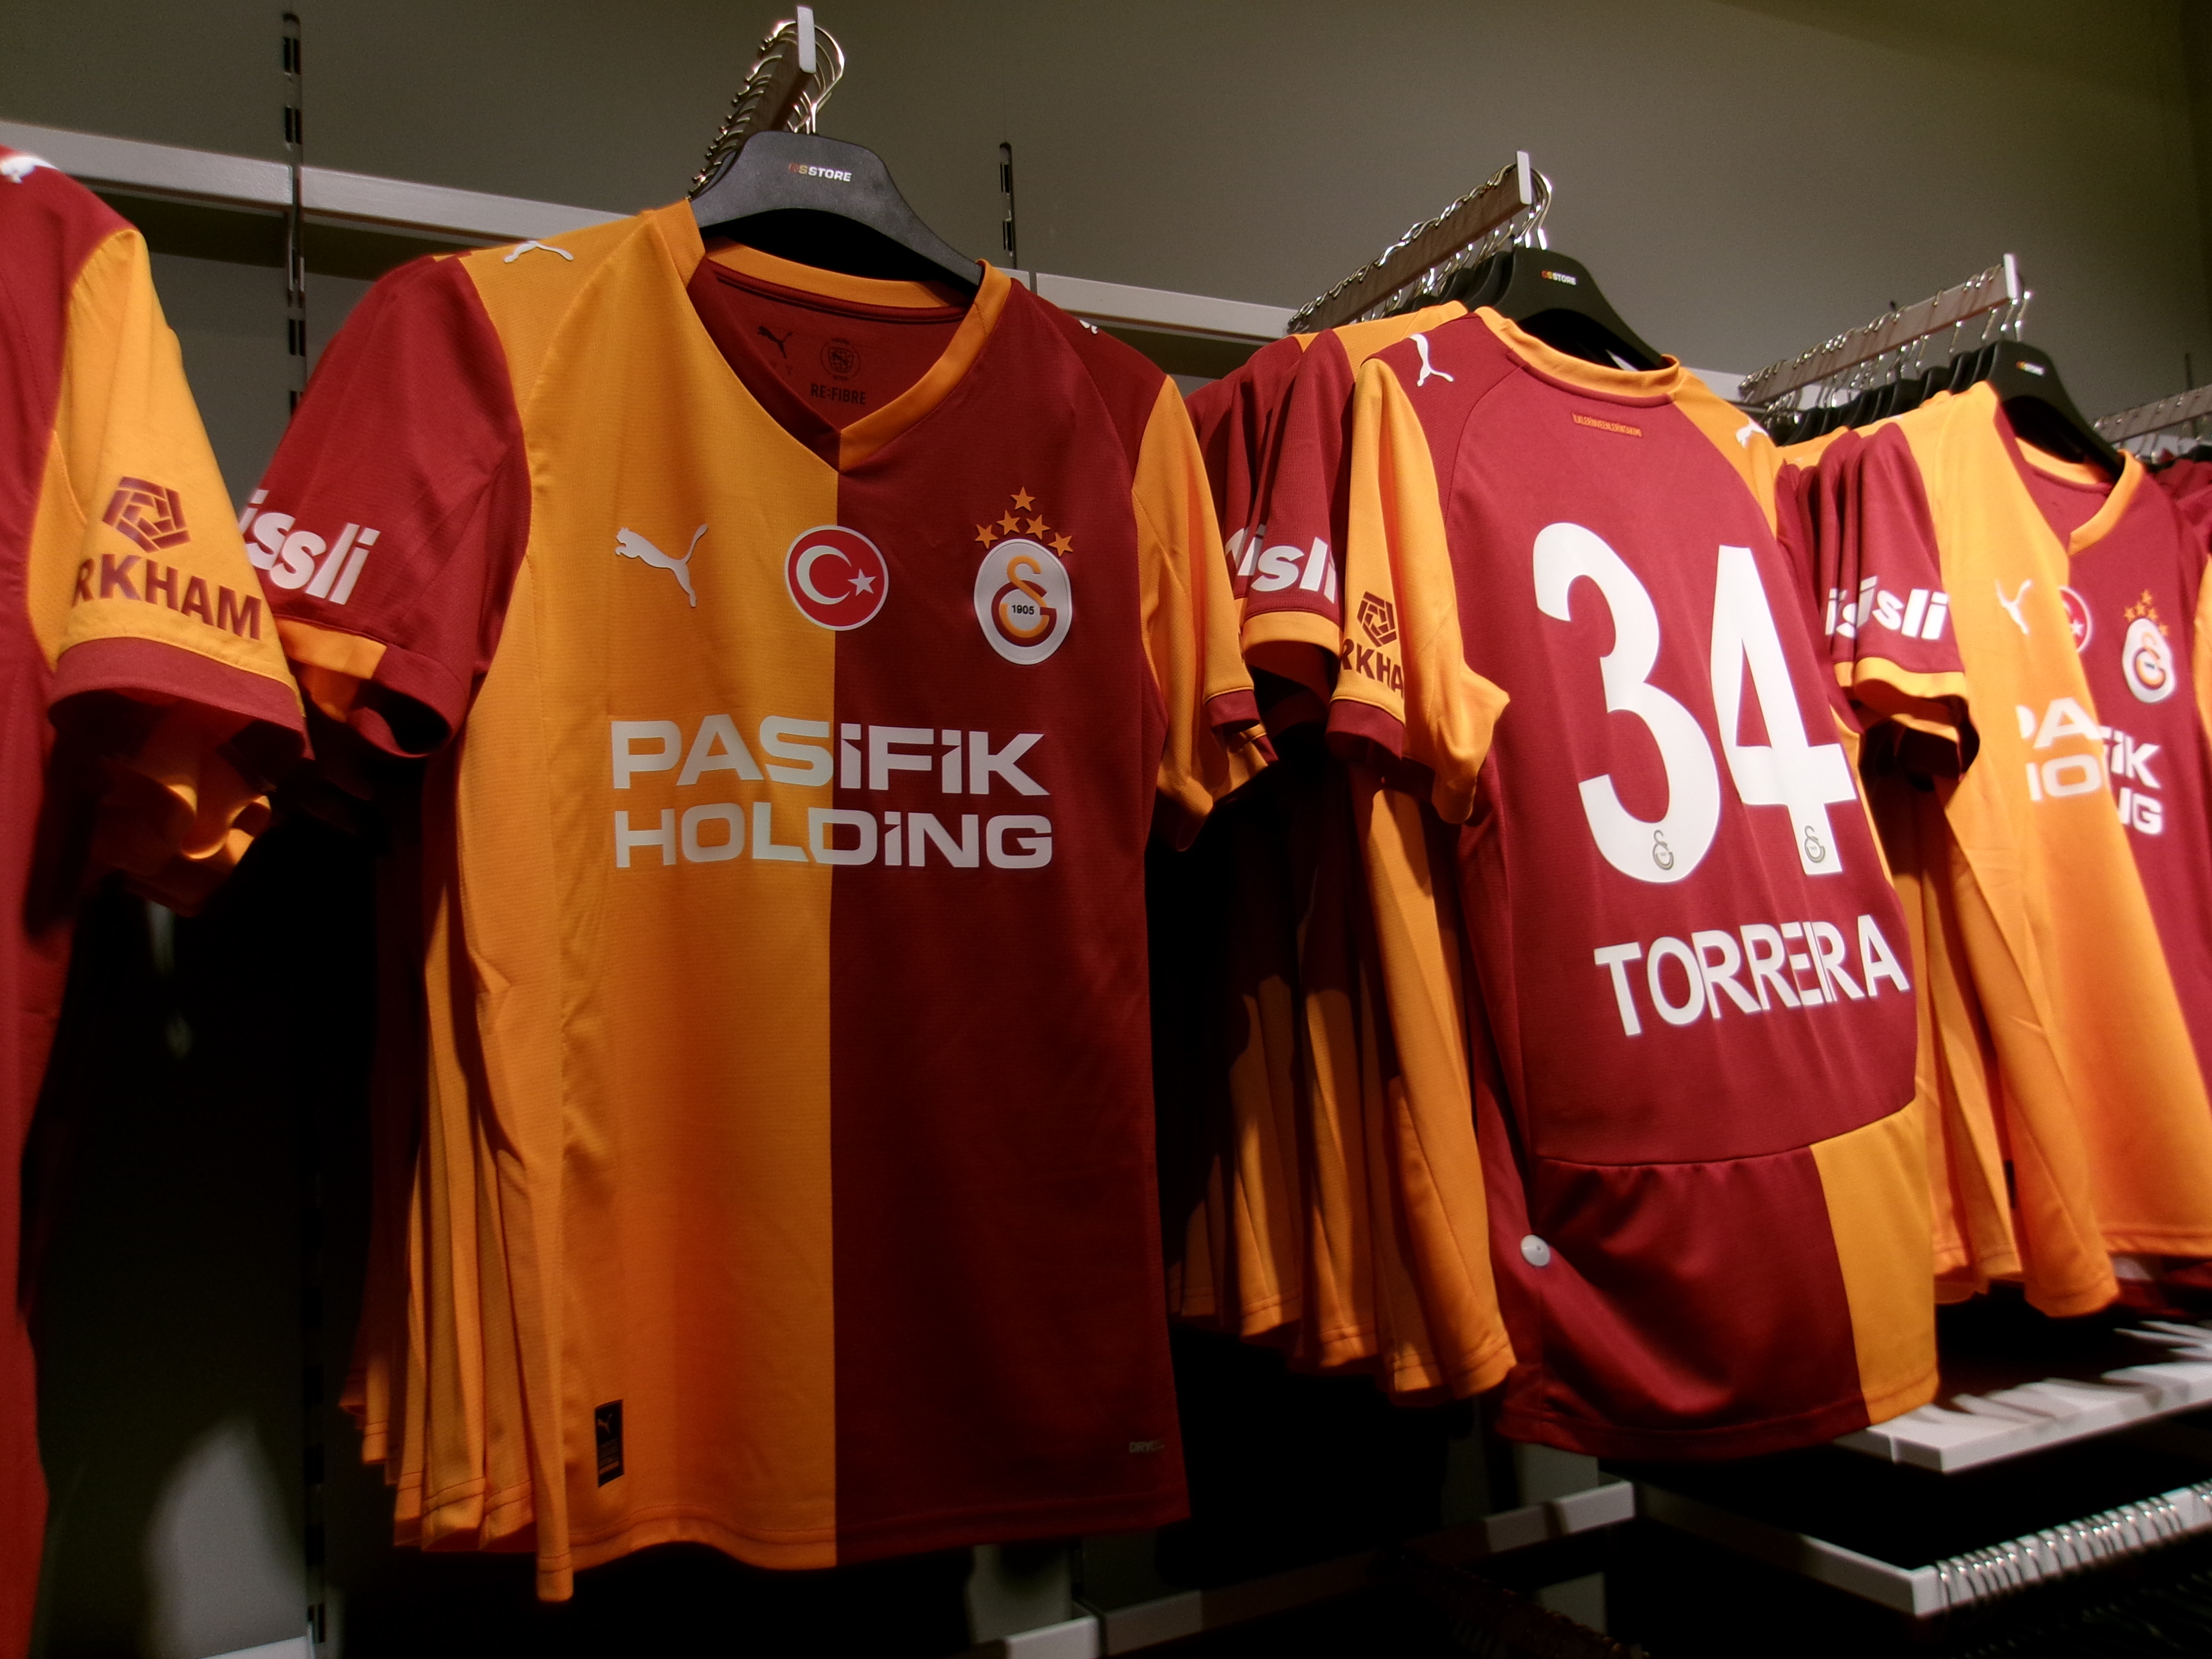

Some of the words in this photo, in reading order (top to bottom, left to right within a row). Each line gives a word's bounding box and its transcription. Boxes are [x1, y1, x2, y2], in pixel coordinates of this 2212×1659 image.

[810, 383, 866, 405] RE:FIBRE
[1011, 604, 1035, 615] 1905
[1533, 522, 1857, 884] 34
[1593, 914, 1910, 1036] TORREIRA
